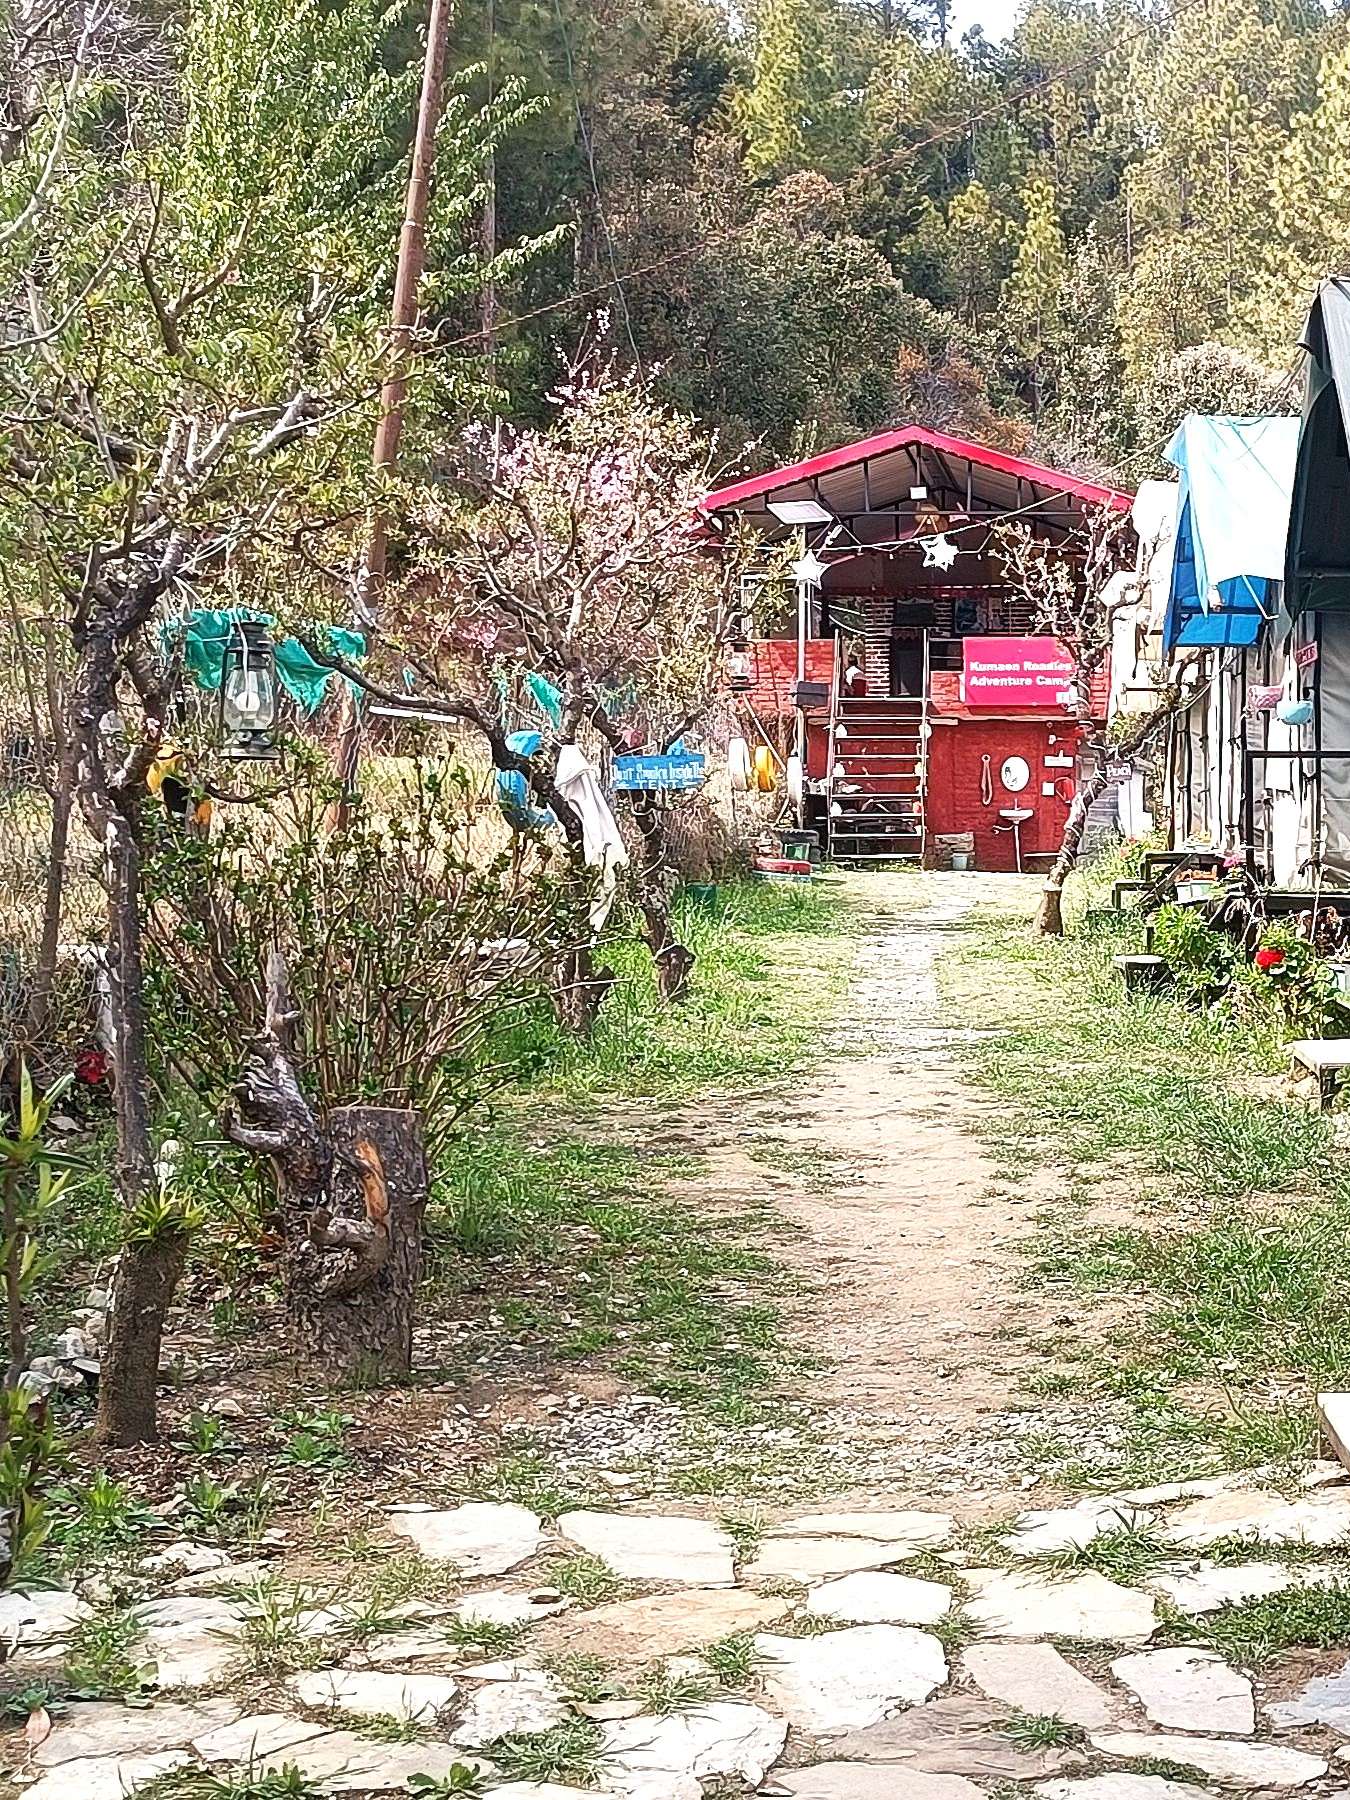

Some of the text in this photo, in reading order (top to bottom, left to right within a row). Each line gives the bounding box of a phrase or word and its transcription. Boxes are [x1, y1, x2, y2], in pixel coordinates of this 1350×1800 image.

[969, 661, 1020, 672] Kumaon
[969, 676, 1071, 688] Adventure Camp
[634, 779, 679, 789] TENT
